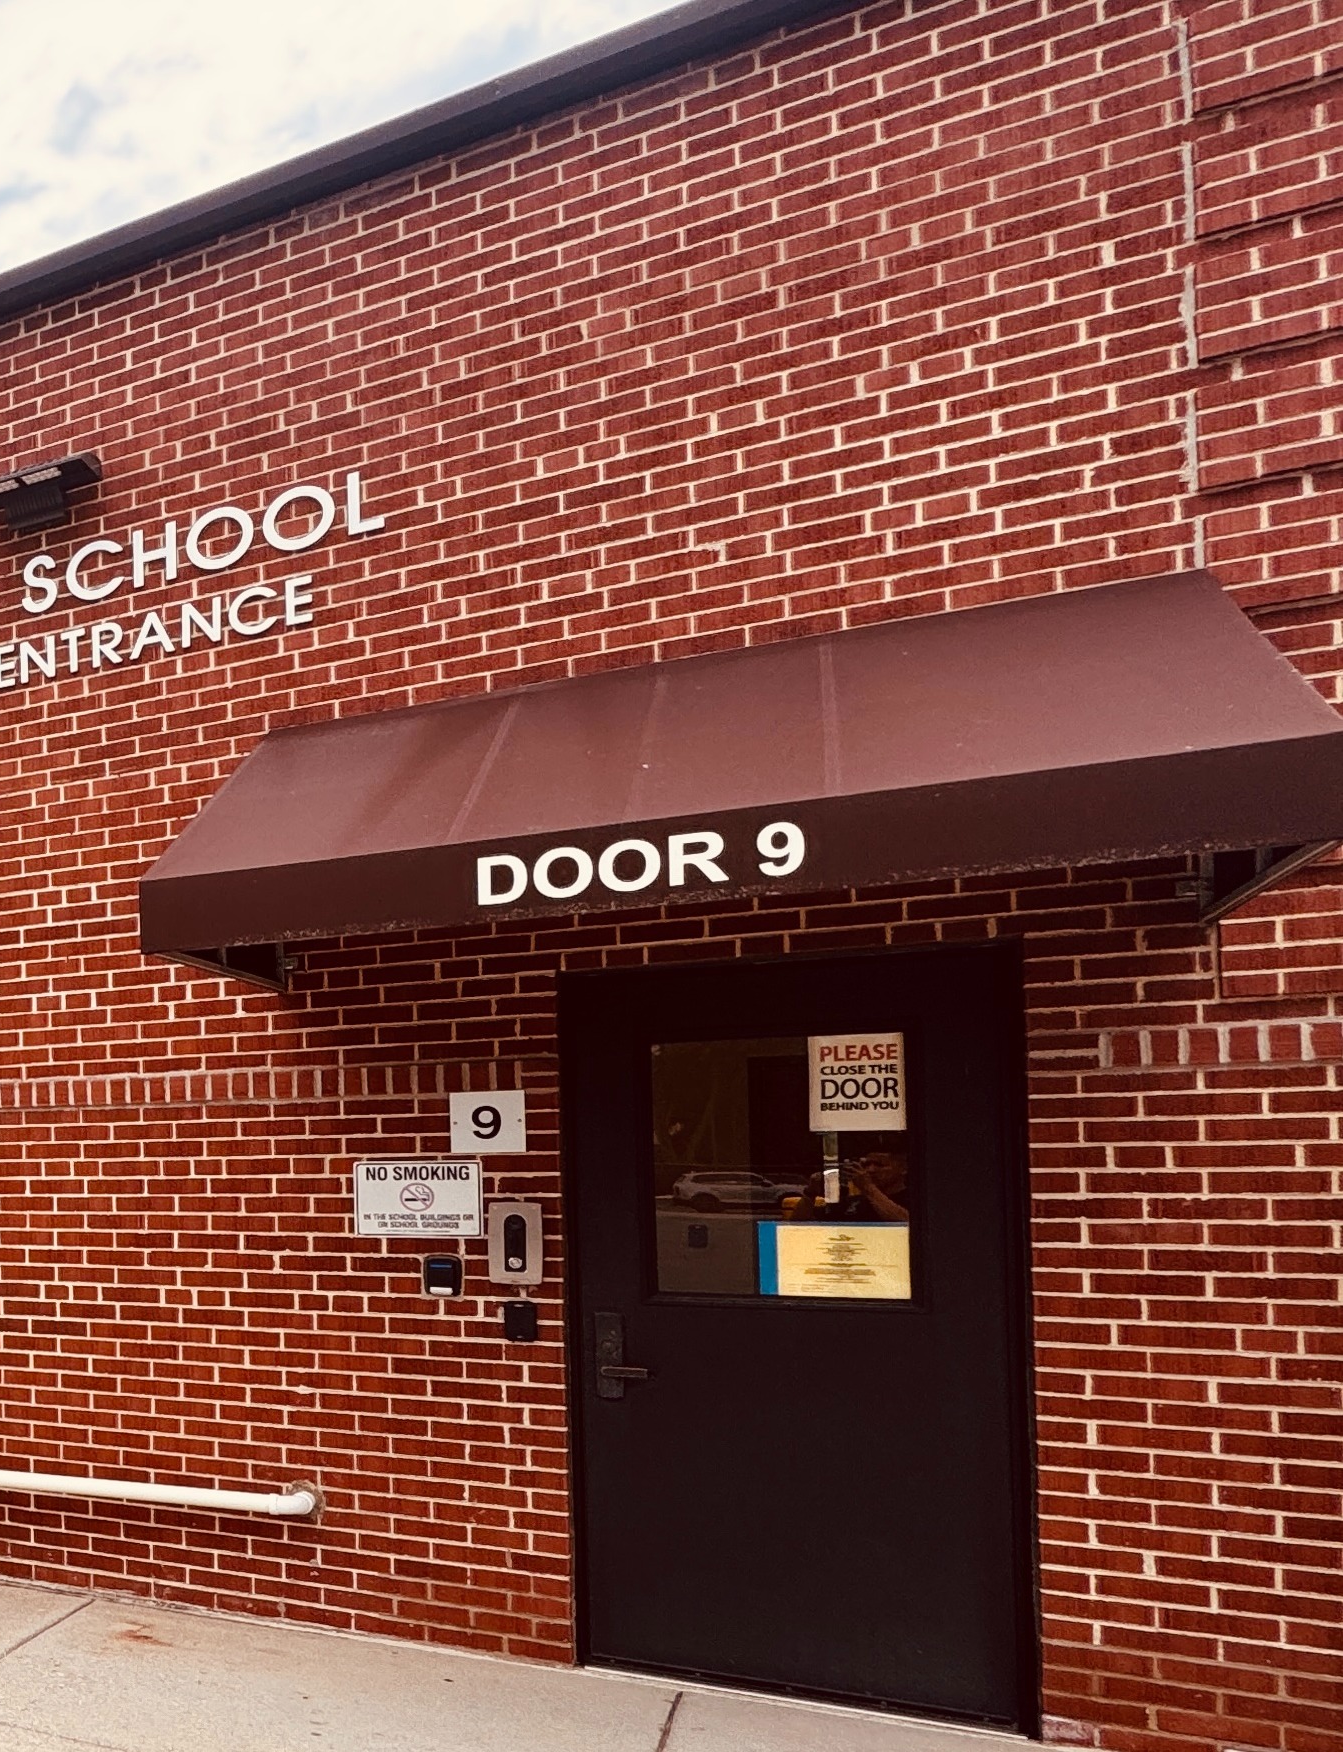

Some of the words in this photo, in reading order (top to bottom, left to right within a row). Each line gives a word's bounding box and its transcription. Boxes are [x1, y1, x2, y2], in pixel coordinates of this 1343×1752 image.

[21, 471, 386, 614] SCHOOL
[476, 831, 730, 906] DOOR
[756, 821, 806, 877] 9
[819, 1043, 898, 1062] PLEASE
[820, 1065, 867, 1076] CLOSE
[868, 1063, 899, 1075] THE
[820, 1077, 899, 1100] DOOR
[820, 1101, 870, 1112] BEHIND
[871, 1101, 900, 1111] YOU
[471, 1105, 502, 1140] 9
[366, 1166, 388, 1181] NO
[393, 1165, 470, 1181] SMOKING
[373, 1213, 386, 1221] THE
[388, 1213, 418, 1221] SCHOOL
[390, 1221, 419, 1229] SCHOOL
